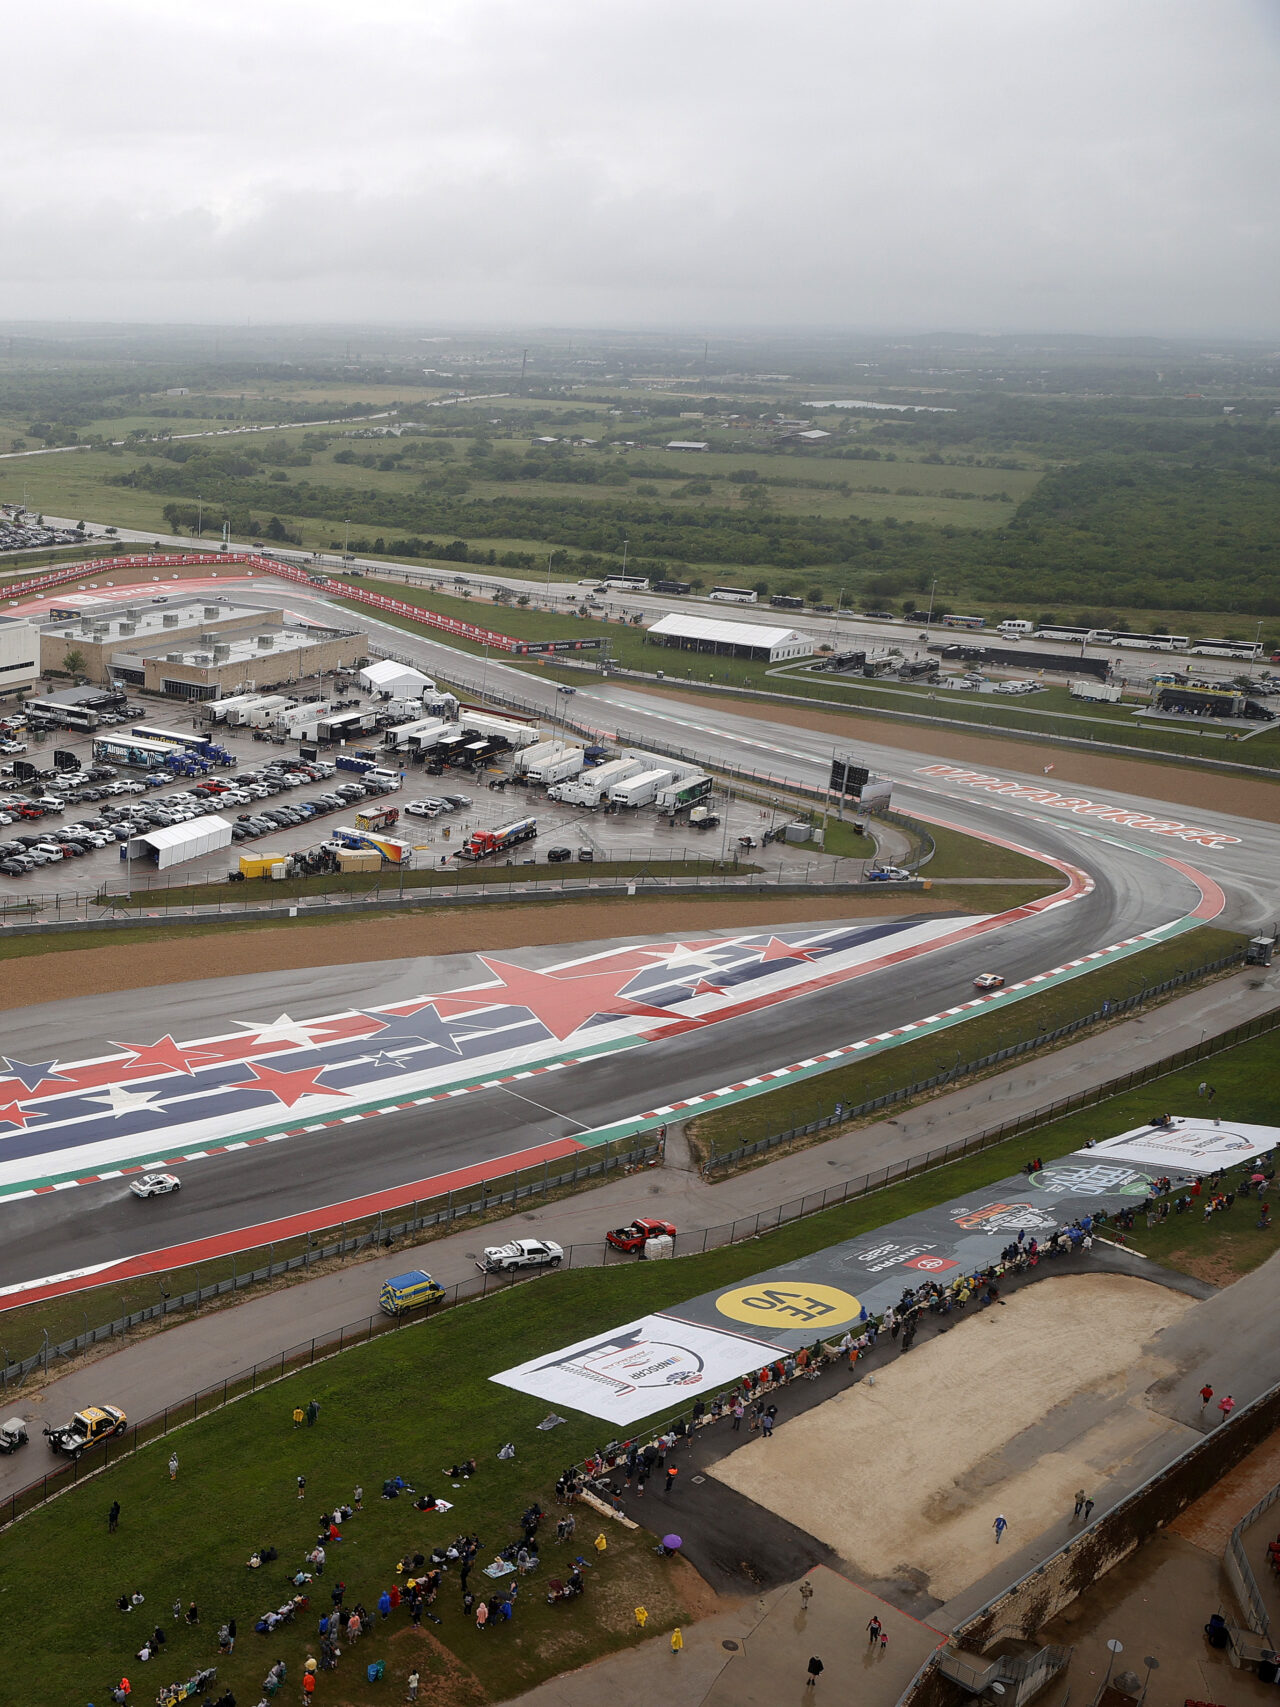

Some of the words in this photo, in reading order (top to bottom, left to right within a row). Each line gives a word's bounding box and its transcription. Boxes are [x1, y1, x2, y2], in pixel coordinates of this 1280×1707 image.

[101, 584, 176, 599] TOYOTA
[106, 744, 128, 756] Airgas
[913, 764, 1243, 849] WHATABURGER
[834, 1107, 842, 1115] 2
[858, 1244, 901, 1262] 225
[866, 1244, 938, 1273] TUNDRA
[741, 1289, 803, 1310] VO
[776, 1297, 838, 1322] FE
[628, 1360, 672, 1380] NASCAR
